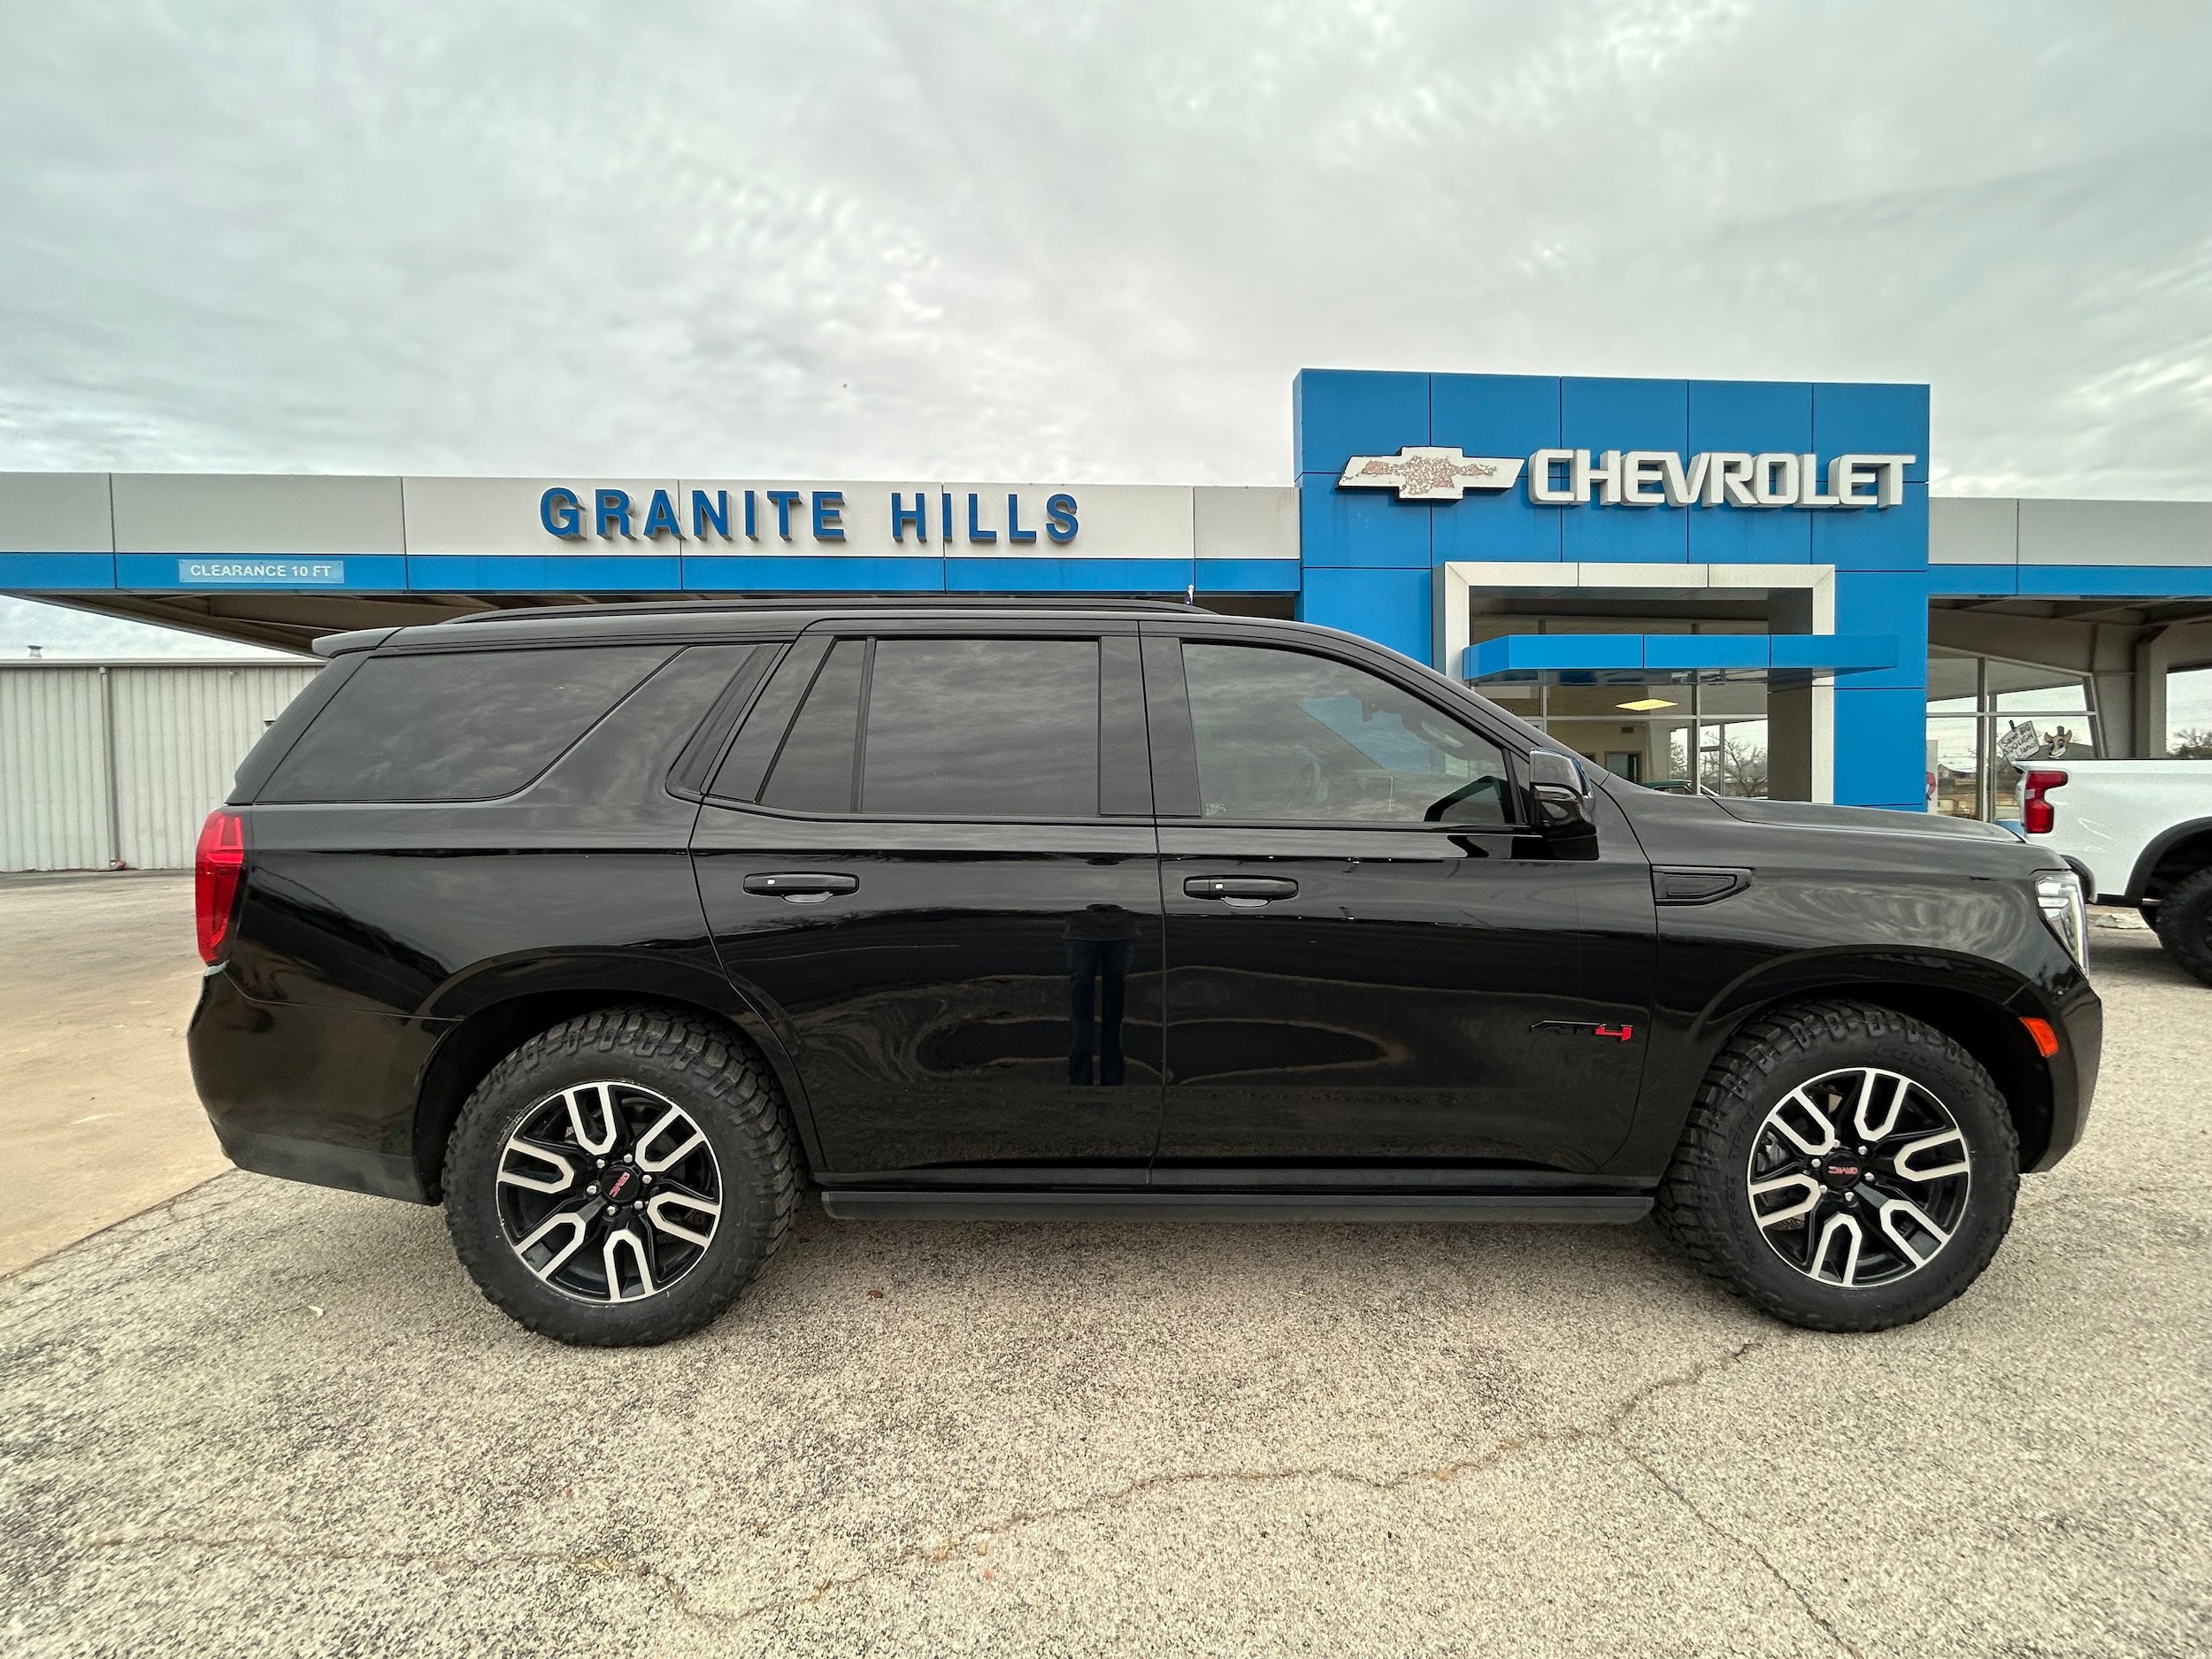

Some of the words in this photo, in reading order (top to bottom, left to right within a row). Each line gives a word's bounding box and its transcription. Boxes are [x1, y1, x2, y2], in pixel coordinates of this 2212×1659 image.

[1528, 449, 1916, 509] CHEVROLET
[540, 487, 847, 541] GRANITE
[891, 492, 1079, 544] HILLS
[189, 564, 287, 578] CLEARANCE
[291, 565, 309, 578] 10
[312, 565, 332, 578] FT
[2018, 723, 2031, 735] BIG
[1528, 1019, 1633, 1042] AT4
[1827, 1165, 1859, 1175] GMC
[609, 1171, 631, 1199] GMC
